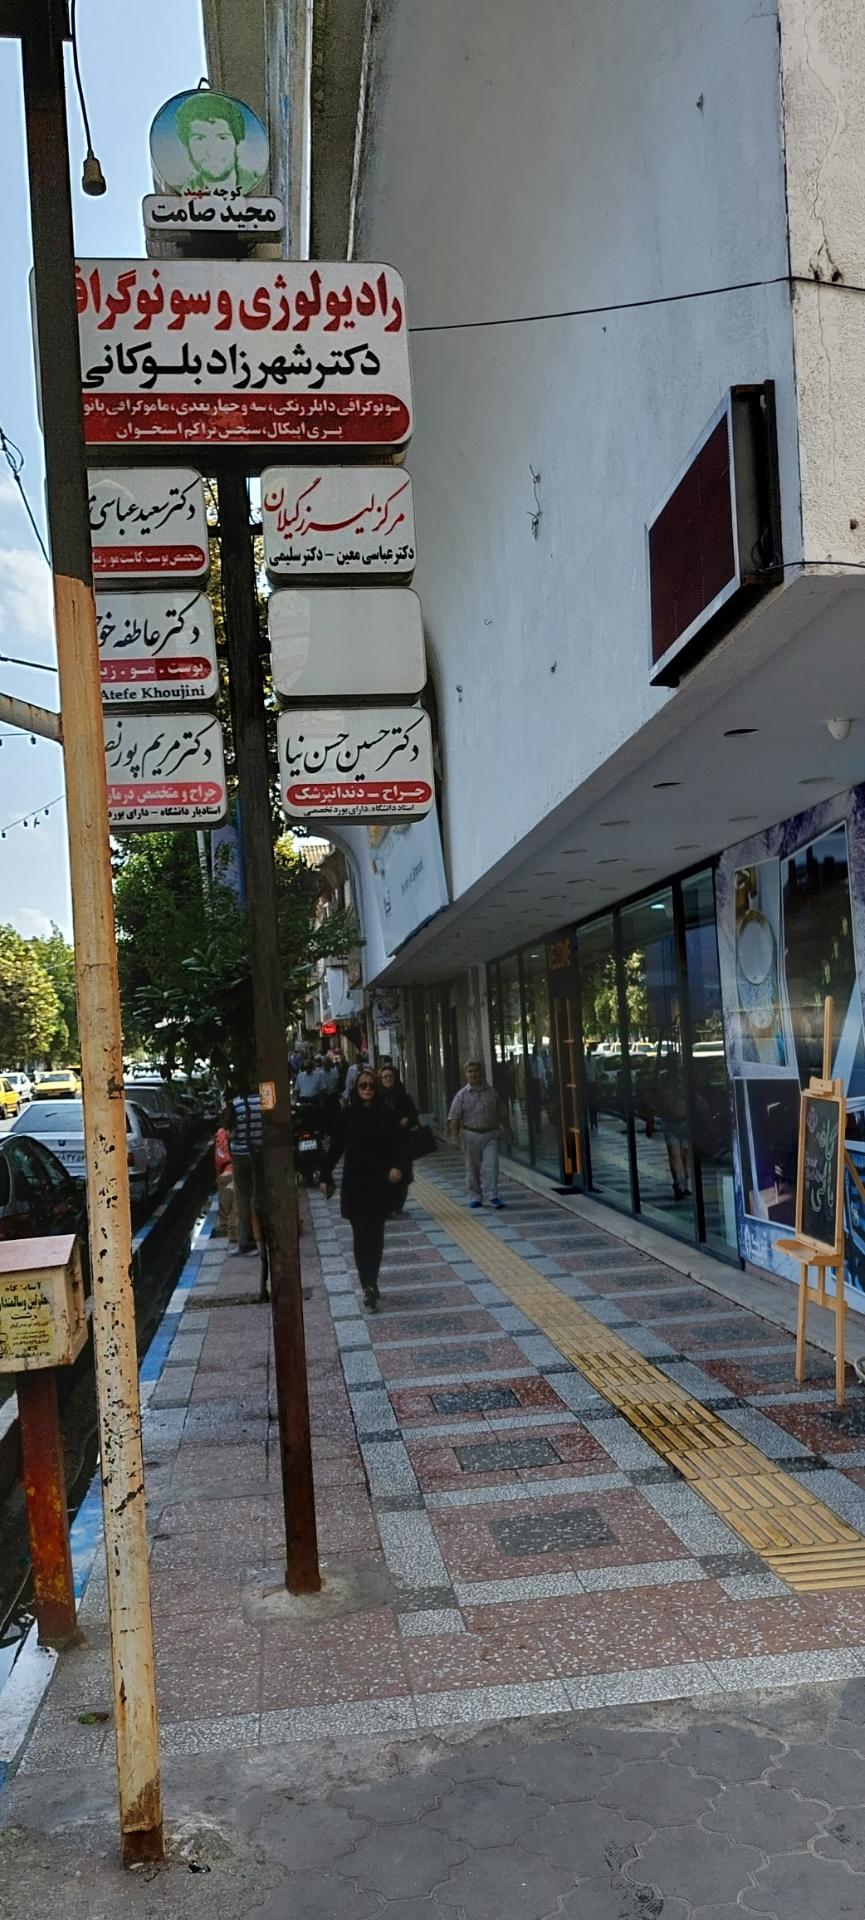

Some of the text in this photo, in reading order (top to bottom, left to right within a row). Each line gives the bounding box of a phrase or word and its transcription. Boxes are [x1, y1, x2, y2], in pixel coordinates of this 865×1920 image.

[213, 186, 242, 201] کوچه
[151, 199, 276, 229] مجید صامت
[239, 269, 403, 332] رادیولوژی
[81, 342, 381, 389] دکتر شهرزاد بلوکانی
[132, 501, 169, 535] سعید
[154, 476, 201, 530] دکتر
[263, 477, 322, 539] گیلان
[372, 479, 410, 536] مرکز
[269, 546, 300, 567] سلیمی
[301, 546, 323, 567] دکتر
[336, 550, 361, 566] معین
[362, 546, 393, 565] عباسی
[394, 545, 415, 565] دکتر
[113, 618, 161, 649] عاطفه
[151, 592, 201, 656] دکتر
[167, 663, 204, 677] پوست
[141, 684, 206, 699] Khoujini
[165, 719, 218, 777] دکتر
[303, 732, 350, 774] حسن
[336, 729, 390, 781] حسین
[375, 715, 425, 772] دکتر
[295, 785, 365, 803] دندانپزشک
[382, 785, 426, 801] جراح
[160, 807, 189, 816] دانشگاه
[192, 805, 221, 818] استادیار
